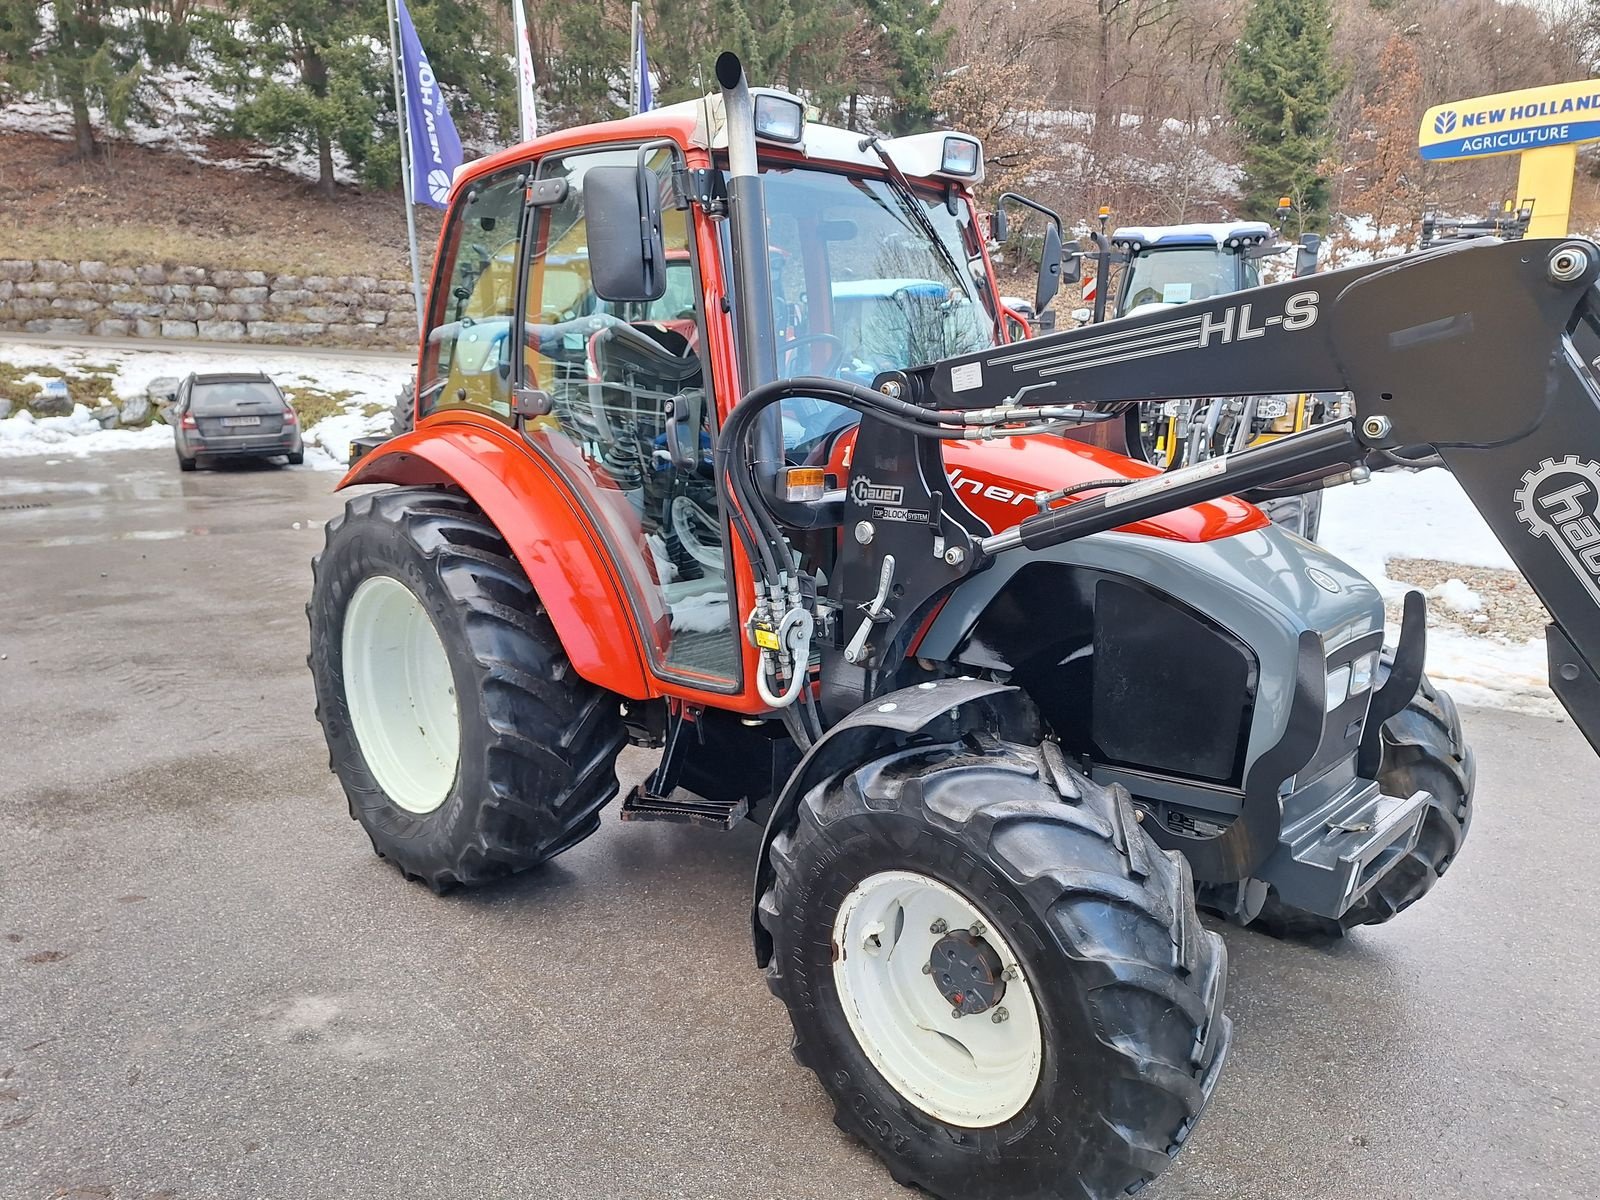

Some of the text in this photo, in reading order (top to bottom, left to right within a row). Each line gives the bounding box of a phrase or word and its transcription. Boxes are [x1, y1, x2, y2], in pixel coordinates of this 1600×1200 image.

[1462, 95, 1600, 127] NEW HOLLAND
[424, 108, 442, 164] NEW
[1461, 125, 1569, 152] AGRICULTURE
[1198, 290, 1320, 348] HL-S
[858, 482, 900, 501] hauer
[883, 509, 907, 519] BLOCK
[907, 512, 927, 520] SYSTEM
